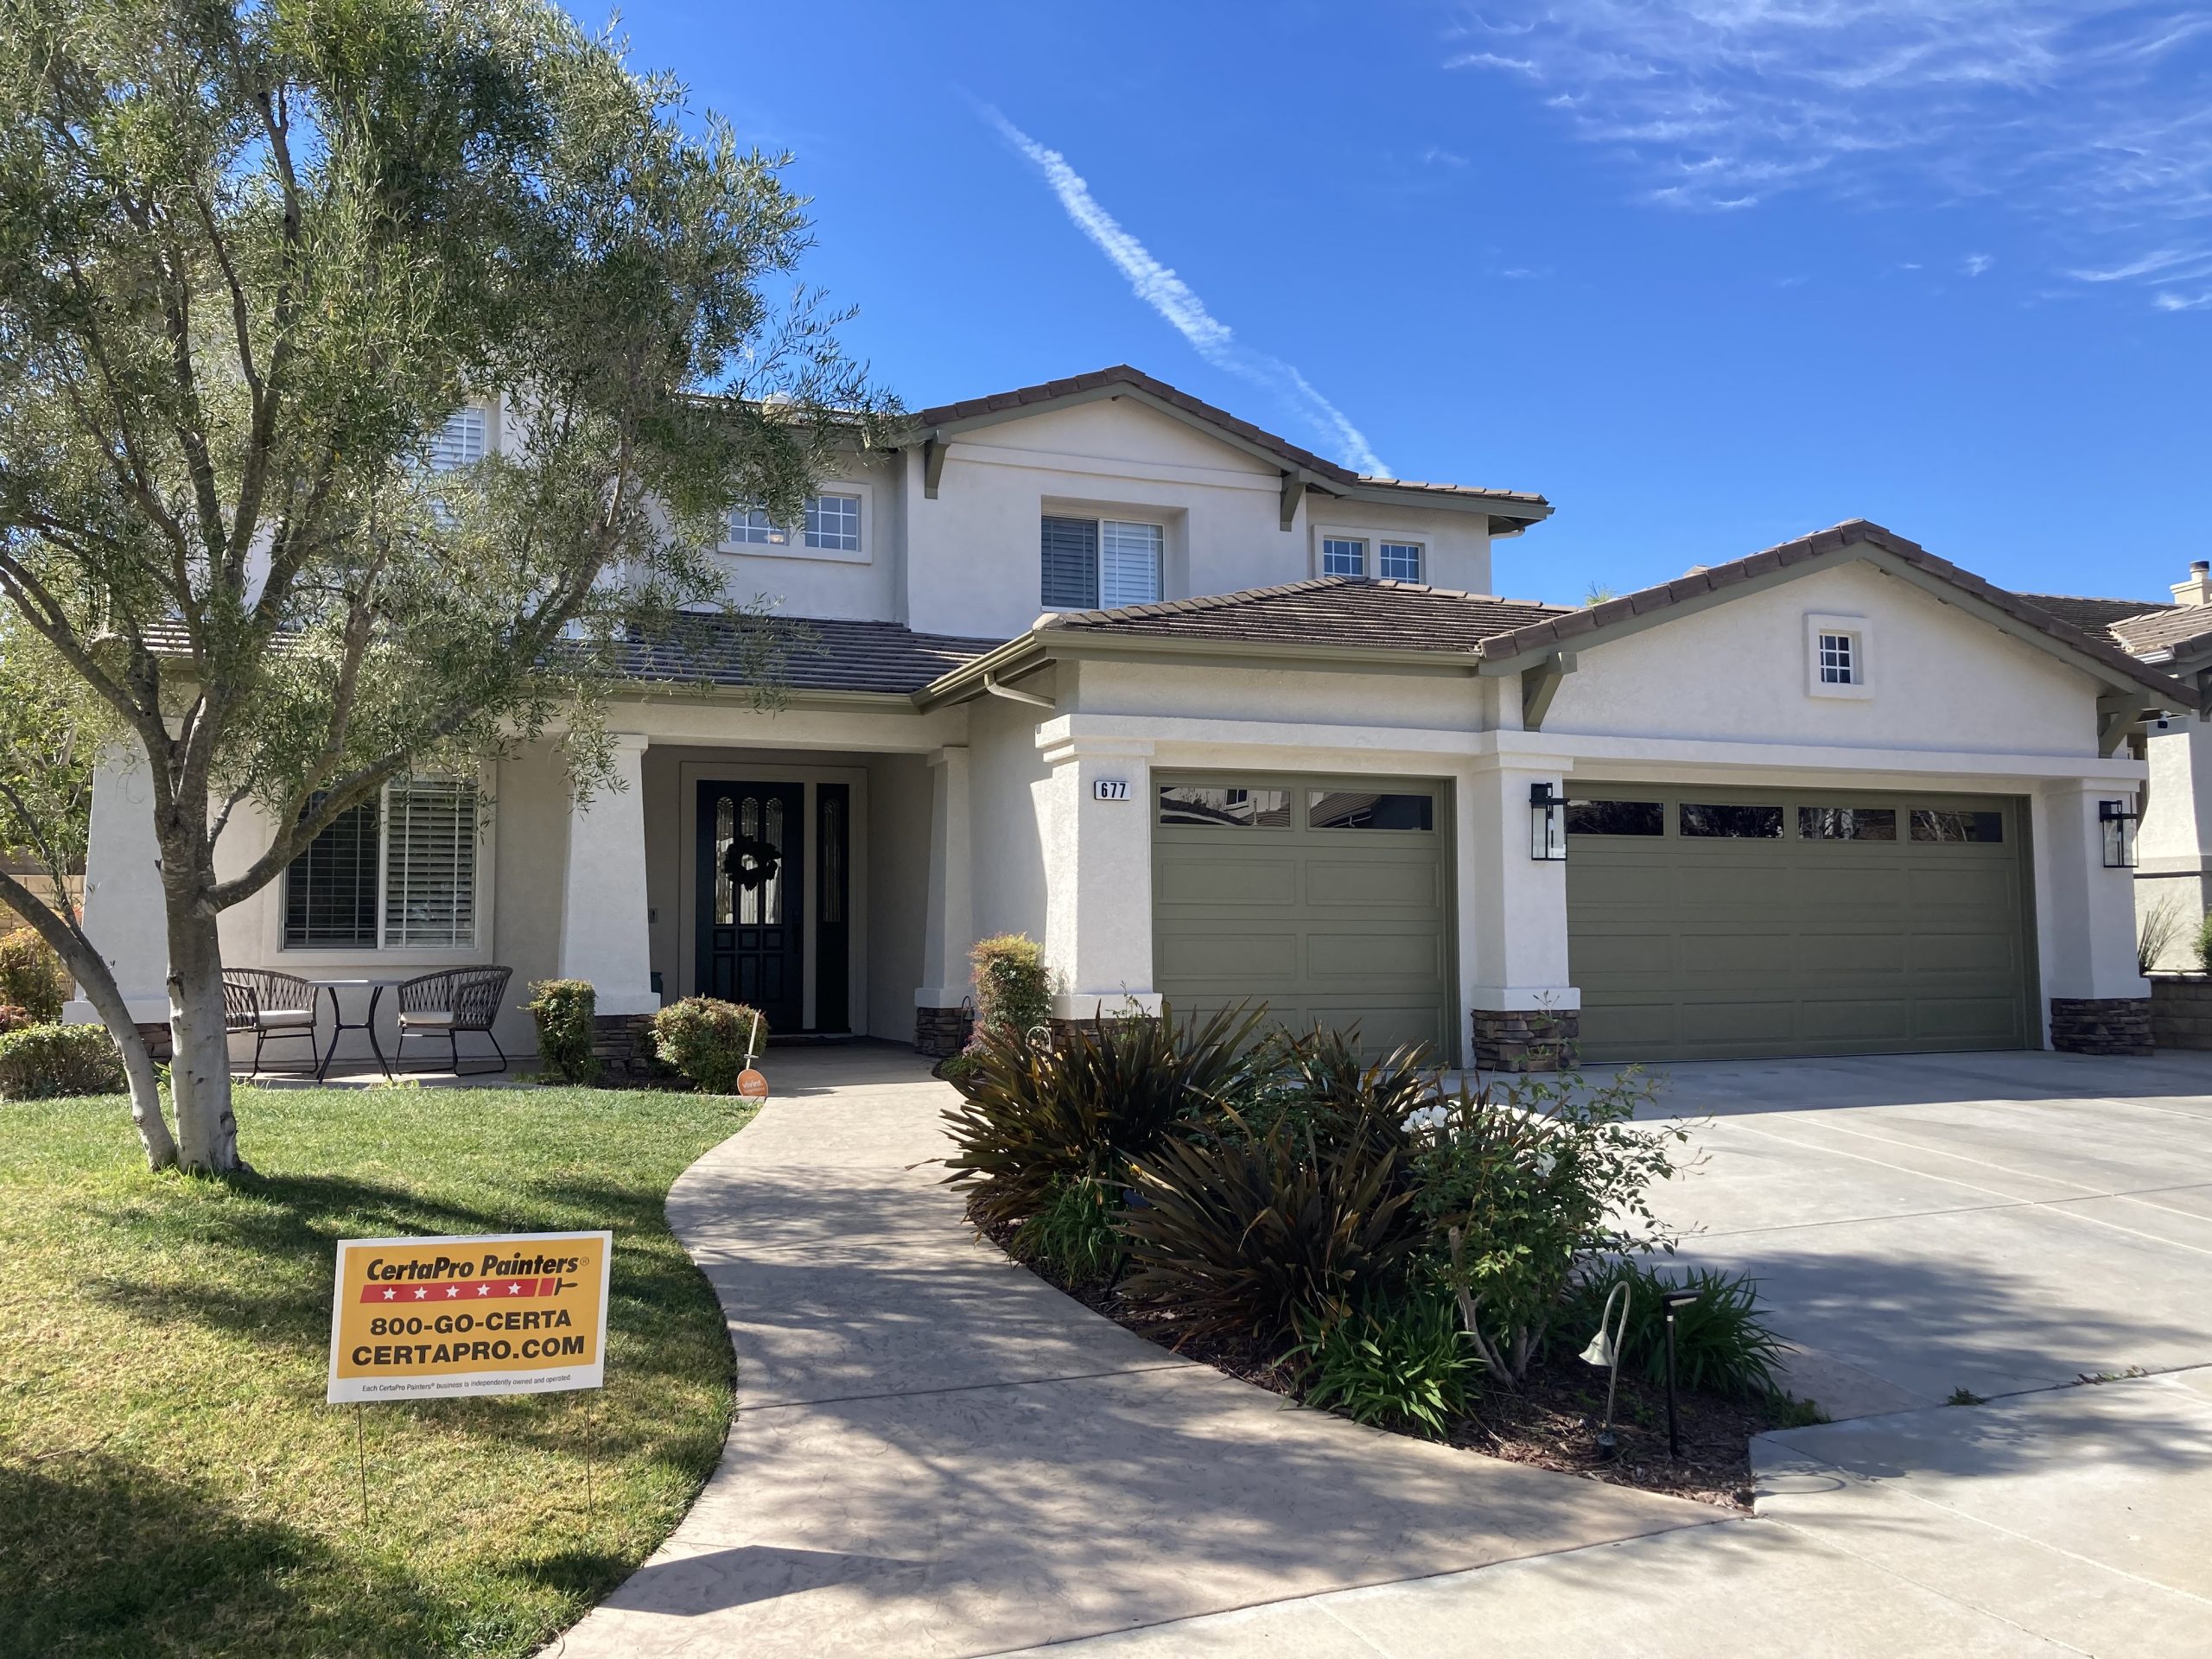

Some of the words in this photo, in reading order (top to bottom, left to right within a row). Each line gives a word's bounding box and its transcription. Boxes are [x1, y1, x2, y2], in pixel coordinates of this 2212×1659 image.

[1102, 783, 1126, 798] 677
[366, 1256, 474, 1281] CertaPro
[370, 1309, 572, 1336] 800-GO-CERTA
[352, 1335, 584, 1366] CERTAPRO.COM
